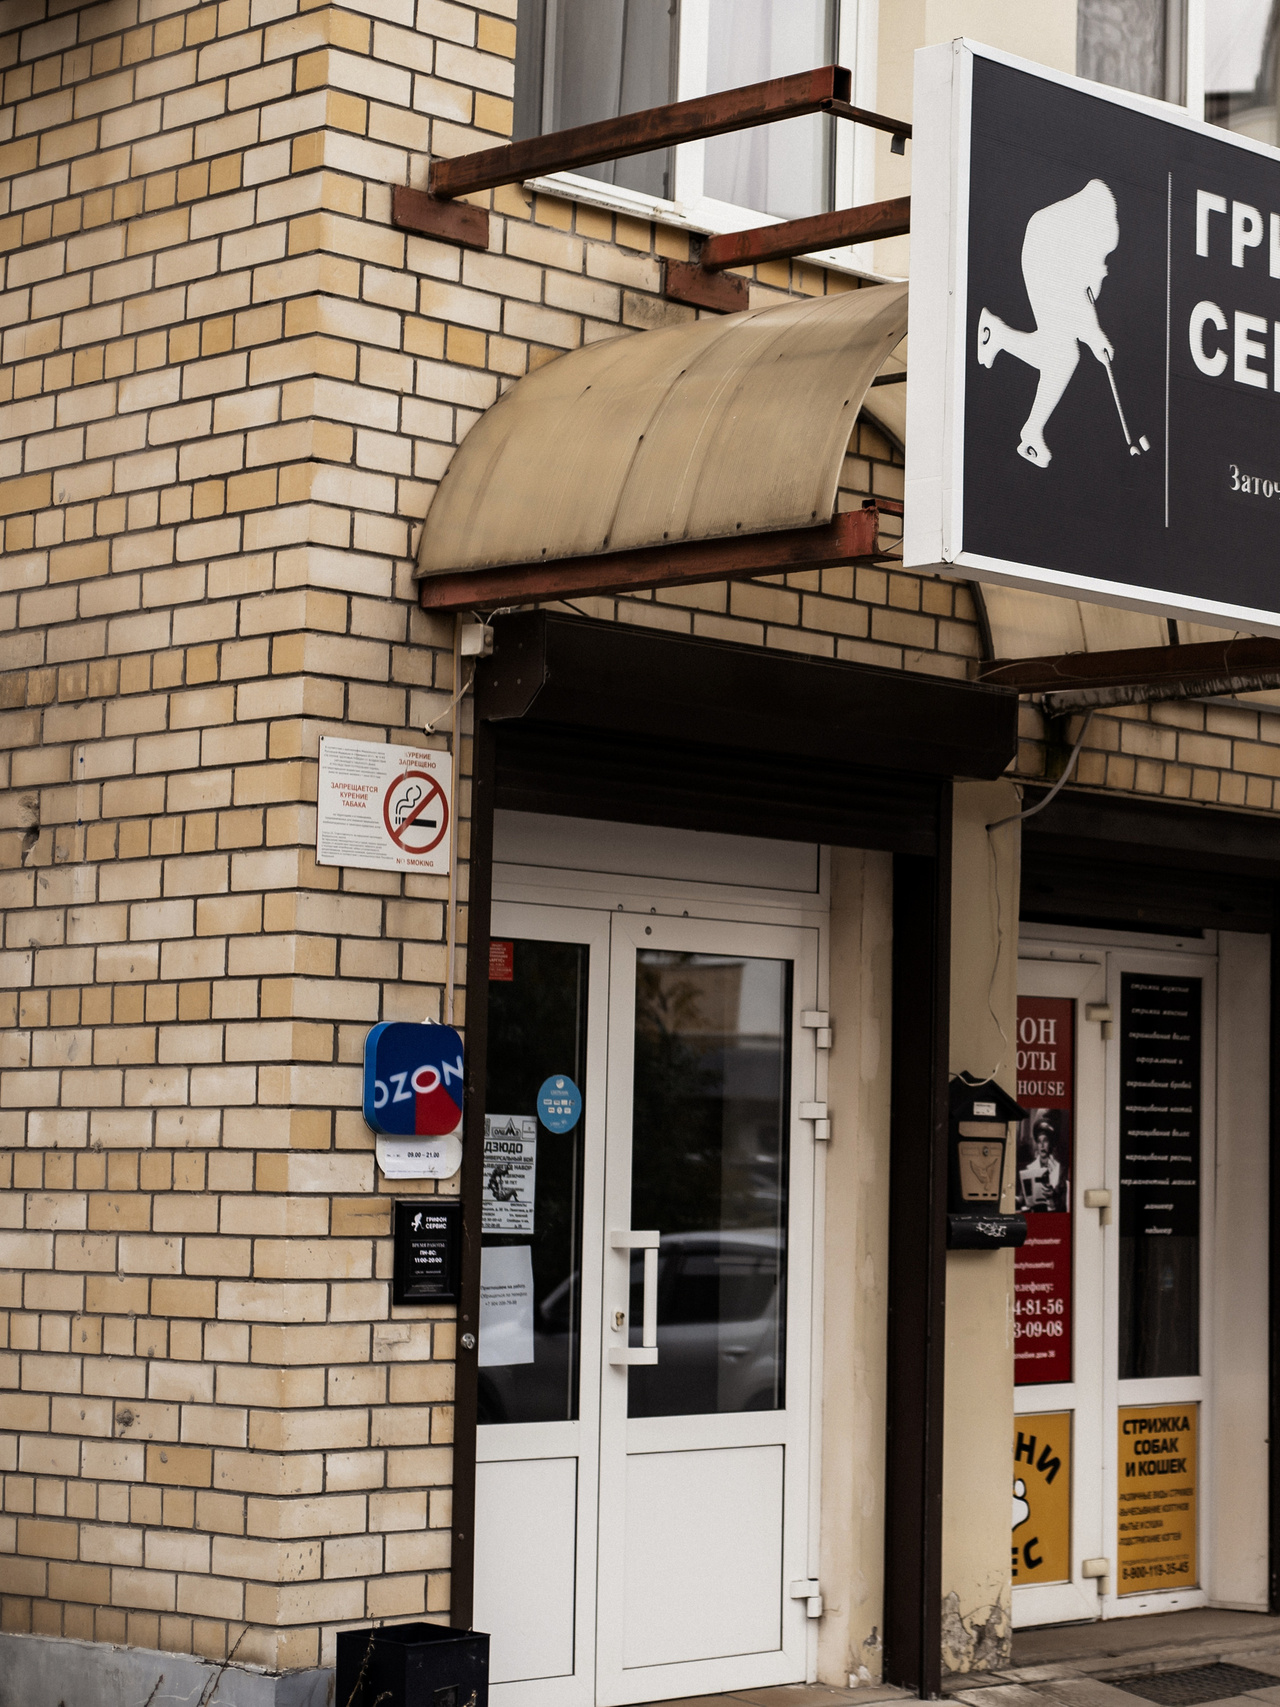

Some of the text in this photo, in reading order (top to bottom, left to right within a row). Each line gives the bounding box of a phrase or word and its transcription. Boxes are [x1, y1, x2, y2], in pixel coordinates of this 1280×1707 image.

[405, 751, 431, 760] УРЕНИЕ
[399, 759, 437, 769] ЗАПРЕЩЕНО
[330, 782, 378, 793] ЗАПРЕЩАЕТСЯ
[340, 792, 368, 800] КУРЕНИЕ
[342, 800, 366, 808] ТАБАКА
[407, 858, 434, 867] SMOKING
[1017, 1017, 1056, 1045] ОН
[1016, 1050, 1056, 1071] ОТЫ
[374, 1055, 464, 1109] OZON
[1018, 1080, 1065, 1096] HOUSE
[407, 1151, 421, 1159] 09.00
[426, 1151, 440, 1159] 21.00
[484, 1141, 523, 1155] ДЗЮДО
[425, 1222, 447, 1230] СЕРВИС
[1014, 1299, 1063, 1315] 4-81-56
[1014, 1321, 1063, 1338] 3-09-08
[1122, 1416, 1190, 1435] СТРИЖКА
[1134, 1437, 1179, 1455] СОБАК
[1014, 1431, 1061, 1485] НИ
[1125, 1458, 1187, 1477] И КОШЕК
